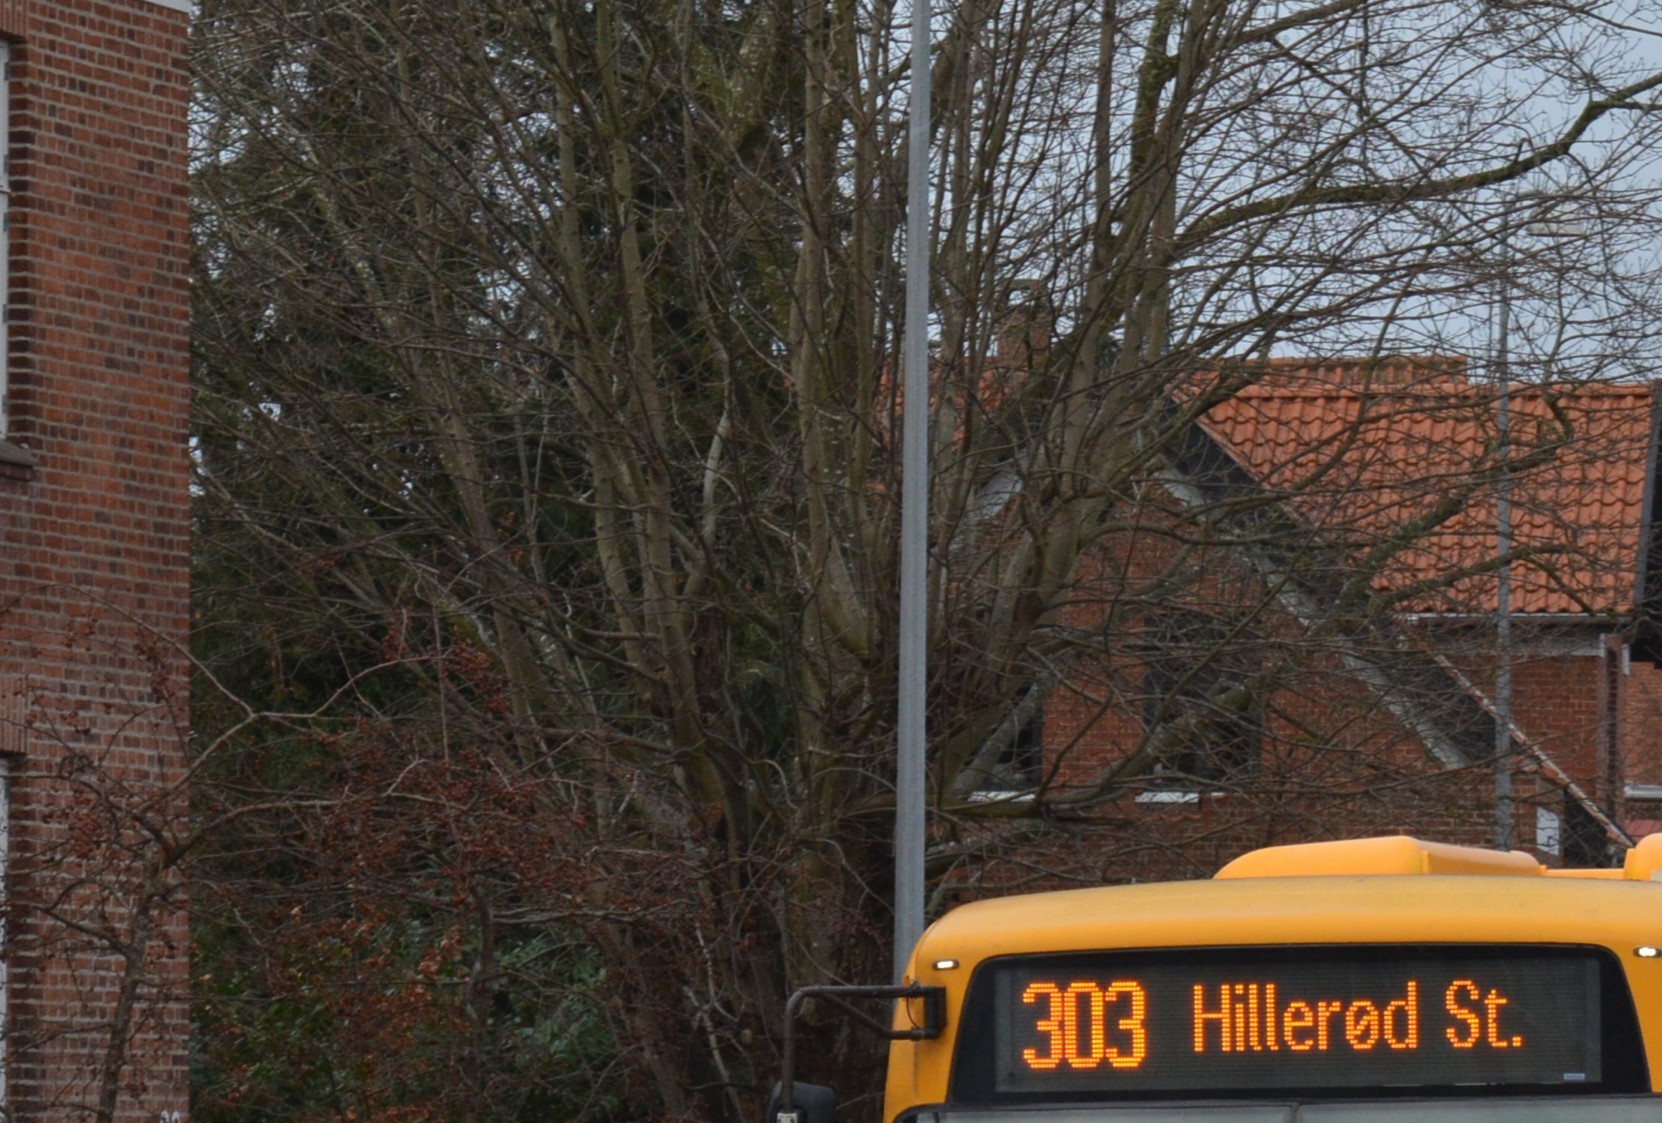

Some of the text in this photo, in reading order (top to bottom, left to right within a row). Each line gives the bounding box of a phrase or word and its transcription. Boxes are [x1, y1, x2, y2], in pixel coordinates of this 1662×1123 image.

[1022, 980, 1522, 1069] 303 Hillerød St.
